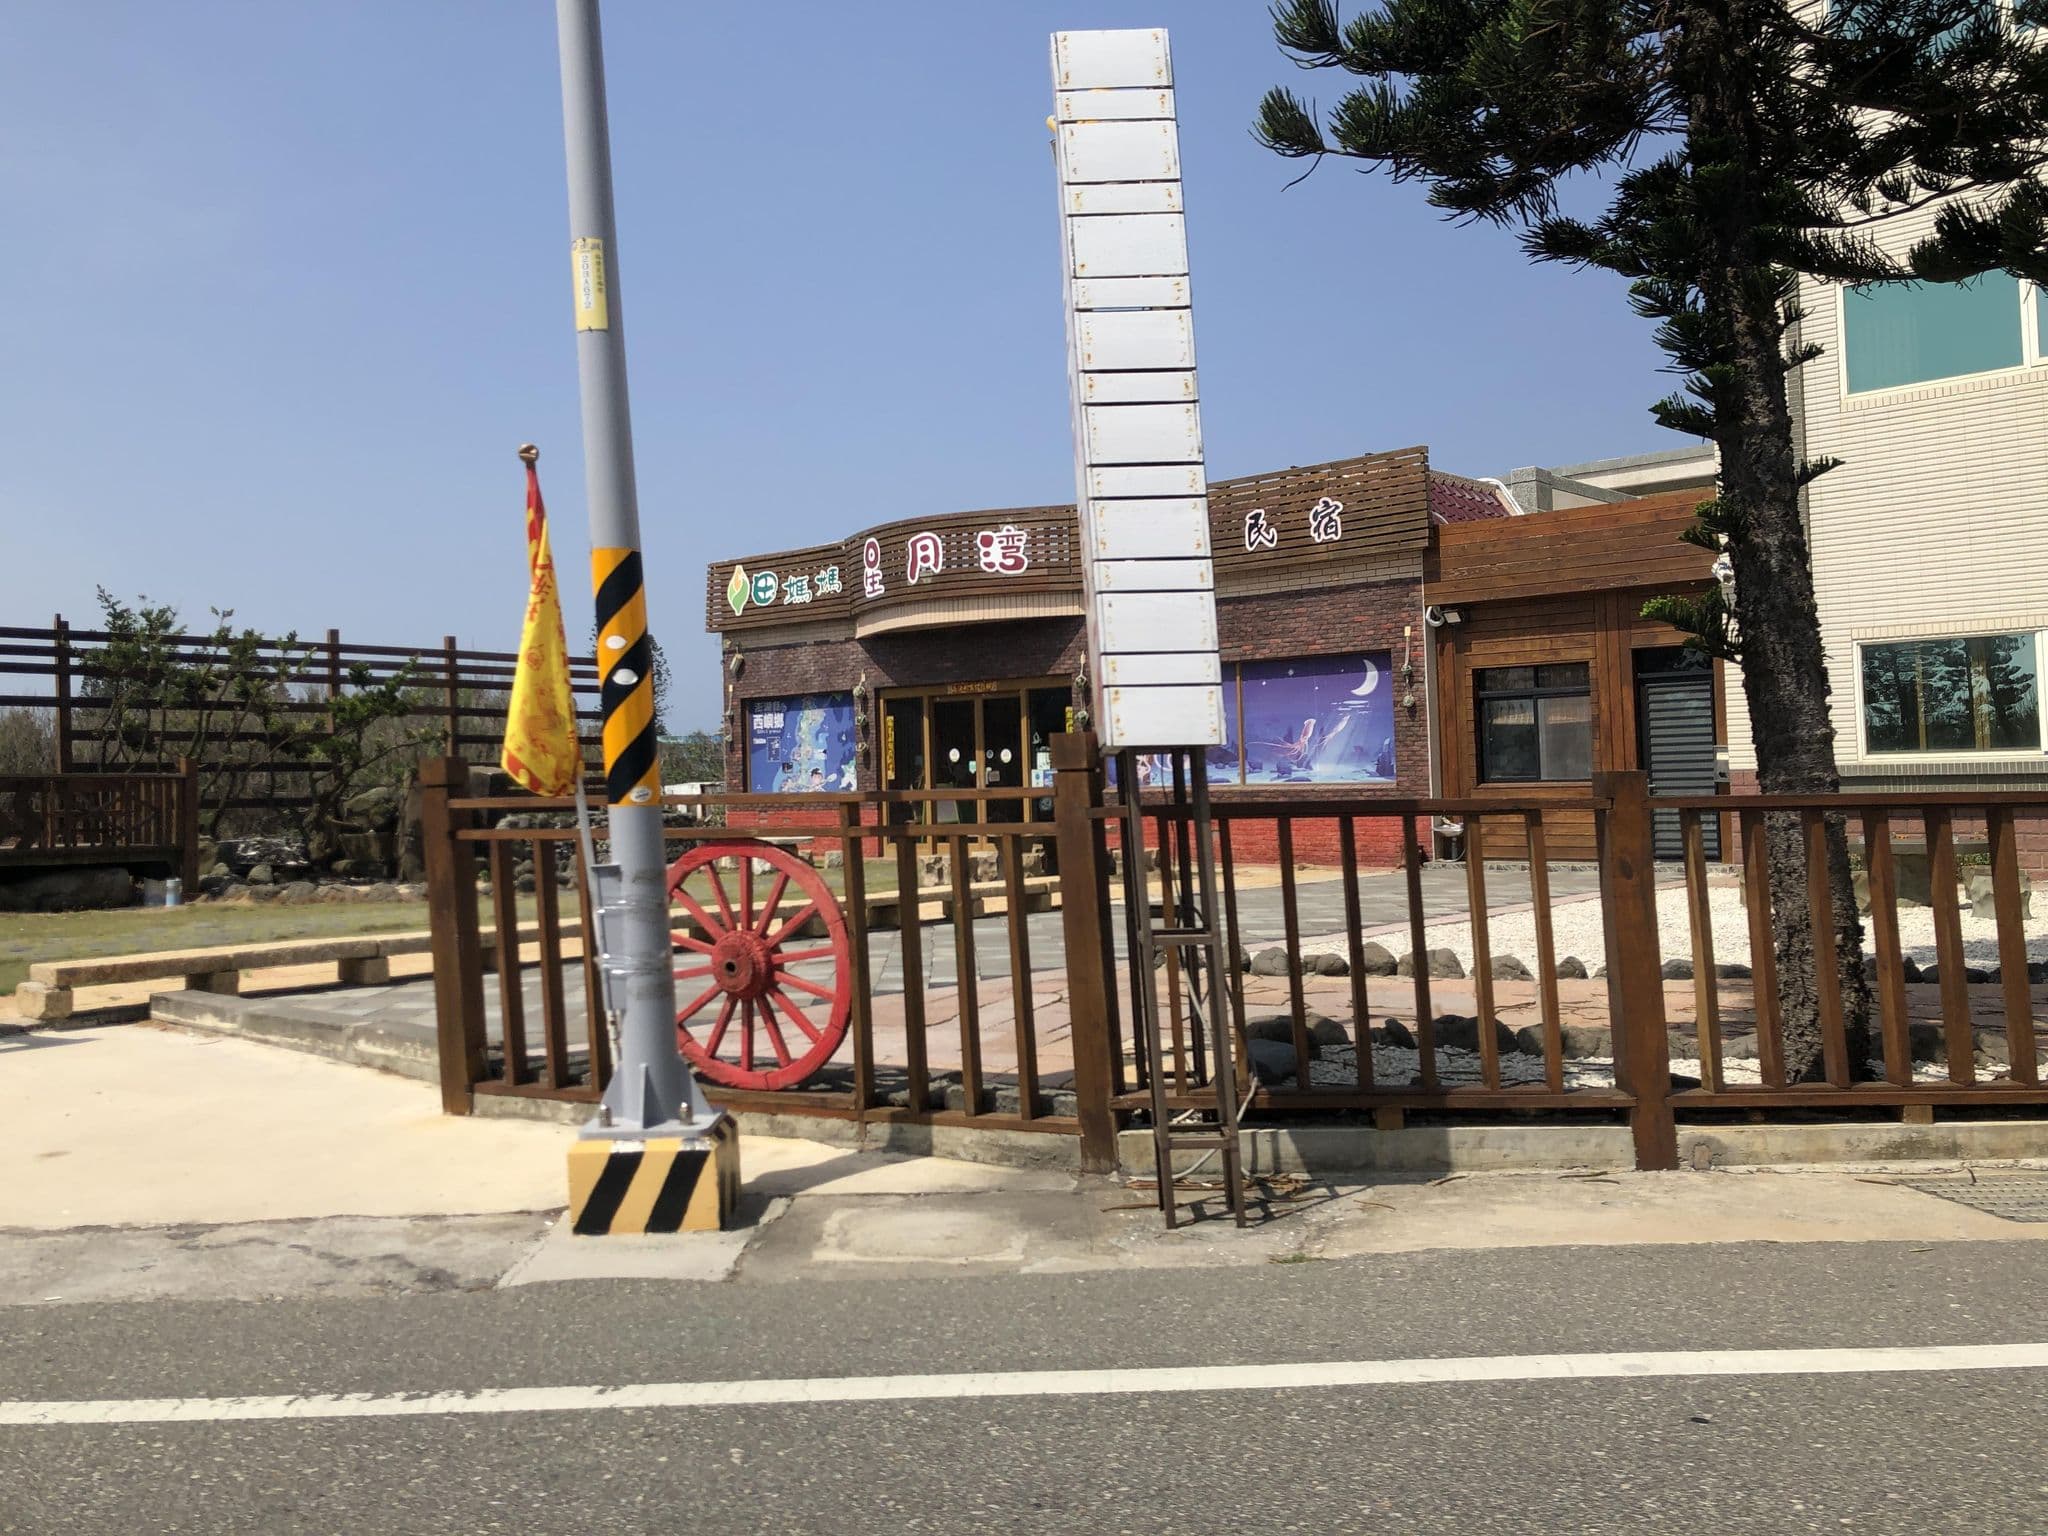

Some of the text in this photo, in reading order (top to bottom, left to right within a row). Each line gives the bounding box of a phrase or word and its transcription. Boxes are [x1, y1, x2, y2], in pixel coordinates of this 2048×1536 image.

[752, 566, 843, 606] 田媽媽
[1245, 497, 1343, 551] 民宿
